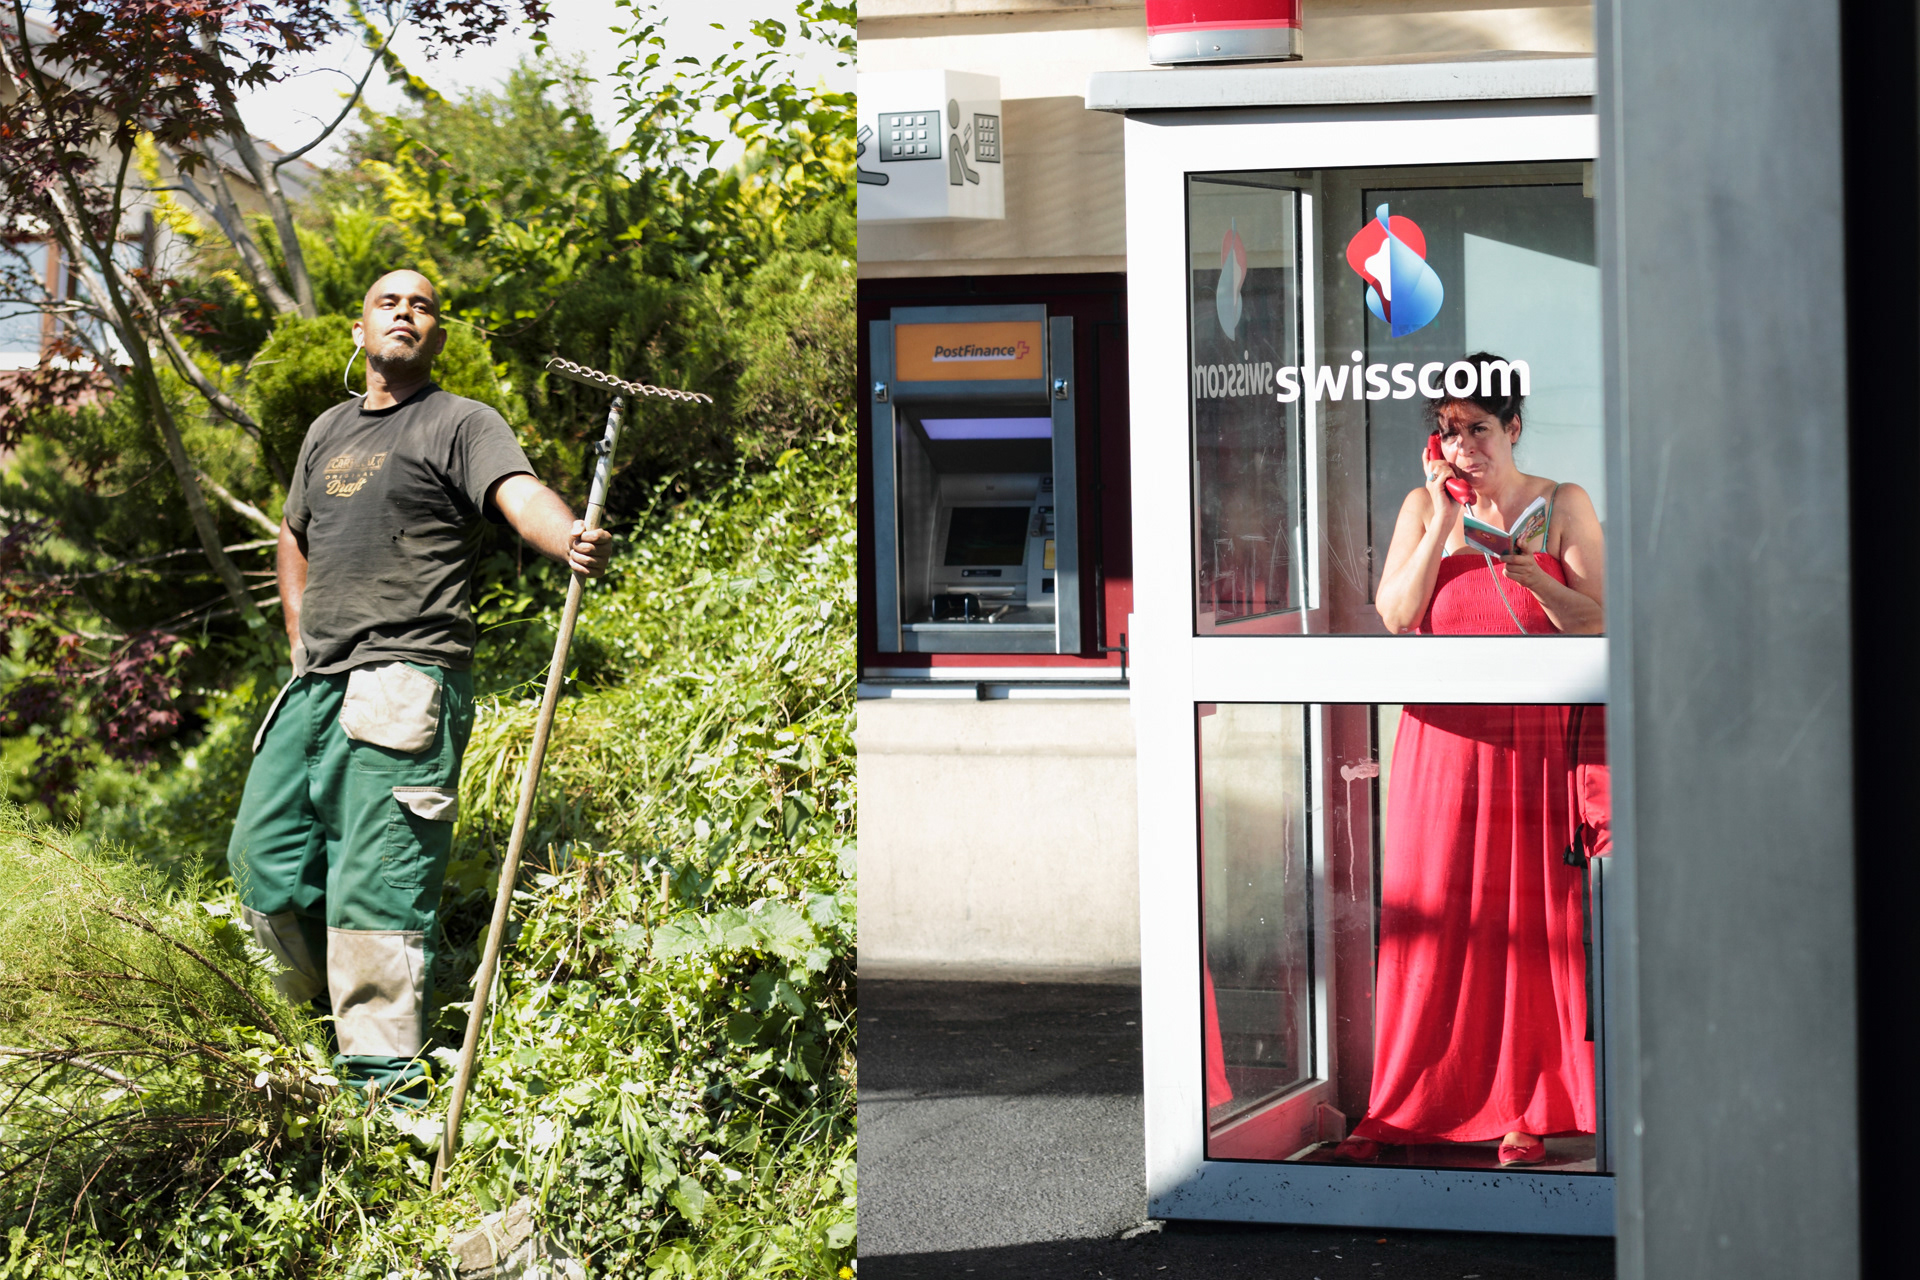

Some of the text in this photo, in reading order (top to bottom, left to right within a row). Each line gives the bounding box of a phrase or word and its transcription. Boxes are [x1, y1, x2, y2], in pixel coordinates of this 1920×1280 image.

[934, 344, 1016, 358] PostFinance
[1275, 350, 1531, 403] swisscom
[325, 477, 368, 497] Draft
